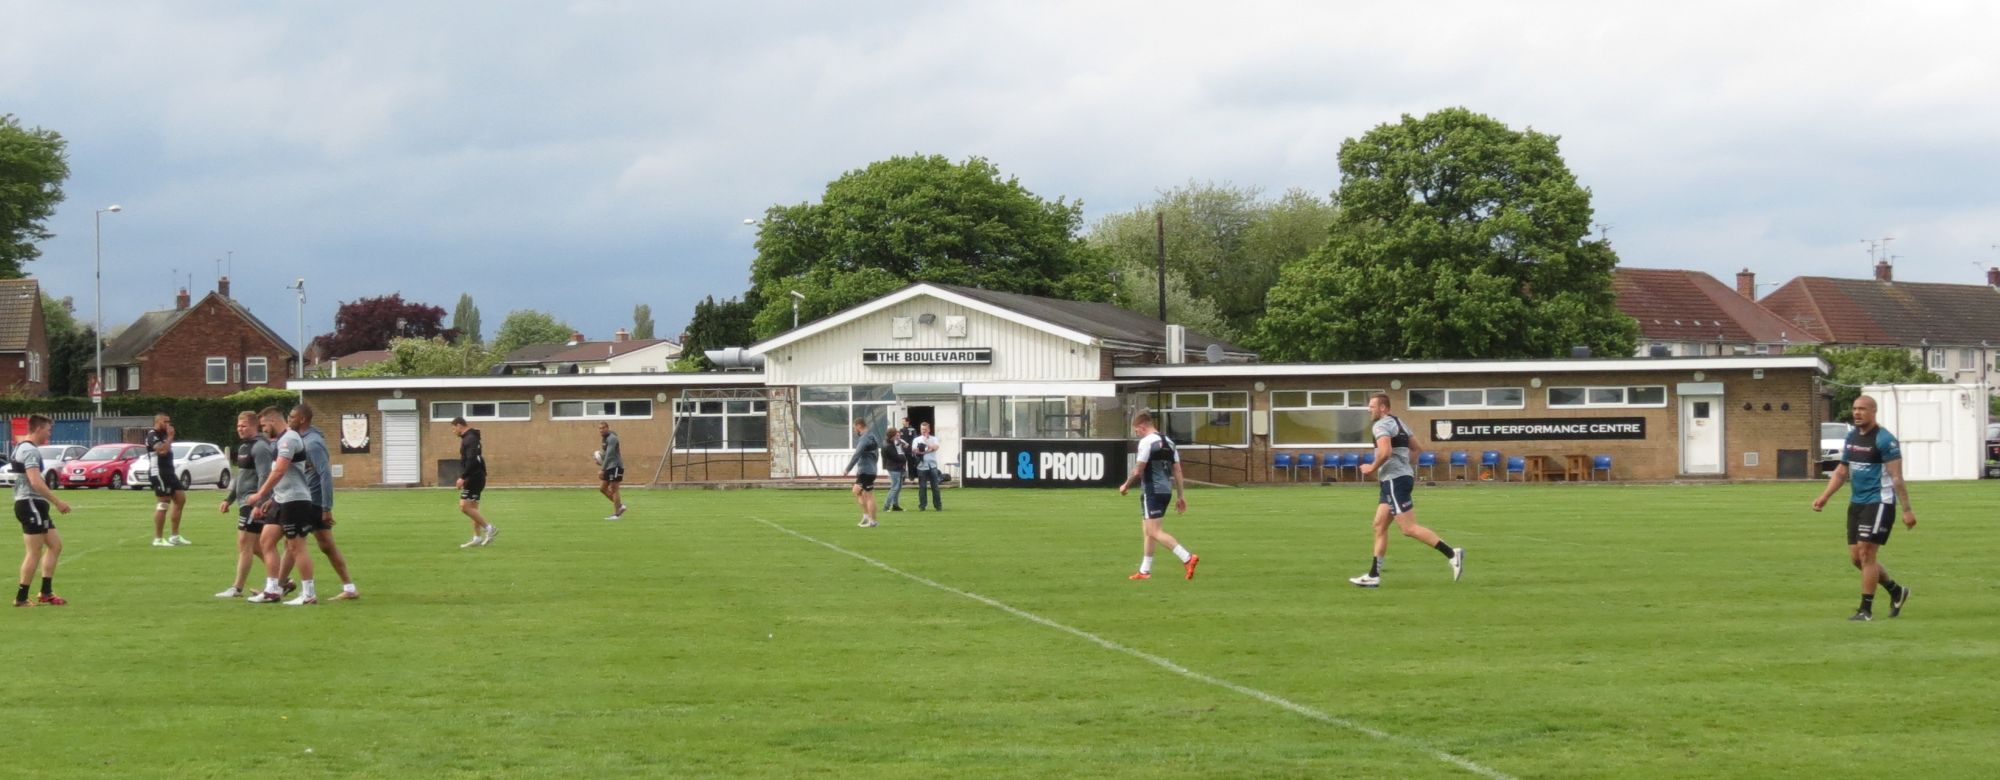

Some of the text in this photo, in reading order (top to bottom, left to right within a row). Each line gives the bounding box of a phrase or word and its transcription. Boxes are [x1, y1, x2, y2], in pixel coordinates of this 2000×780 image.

[879, 352, 975, 361] THE BOULEVARD
[1456, 424, 1640, 435] ELITE PERFORMANCE CENTRE
[966, 451, 1012, 479] HULL
[1017, 451, 1034, 479] &
[1040, 452, 1104, 480] PROUD
